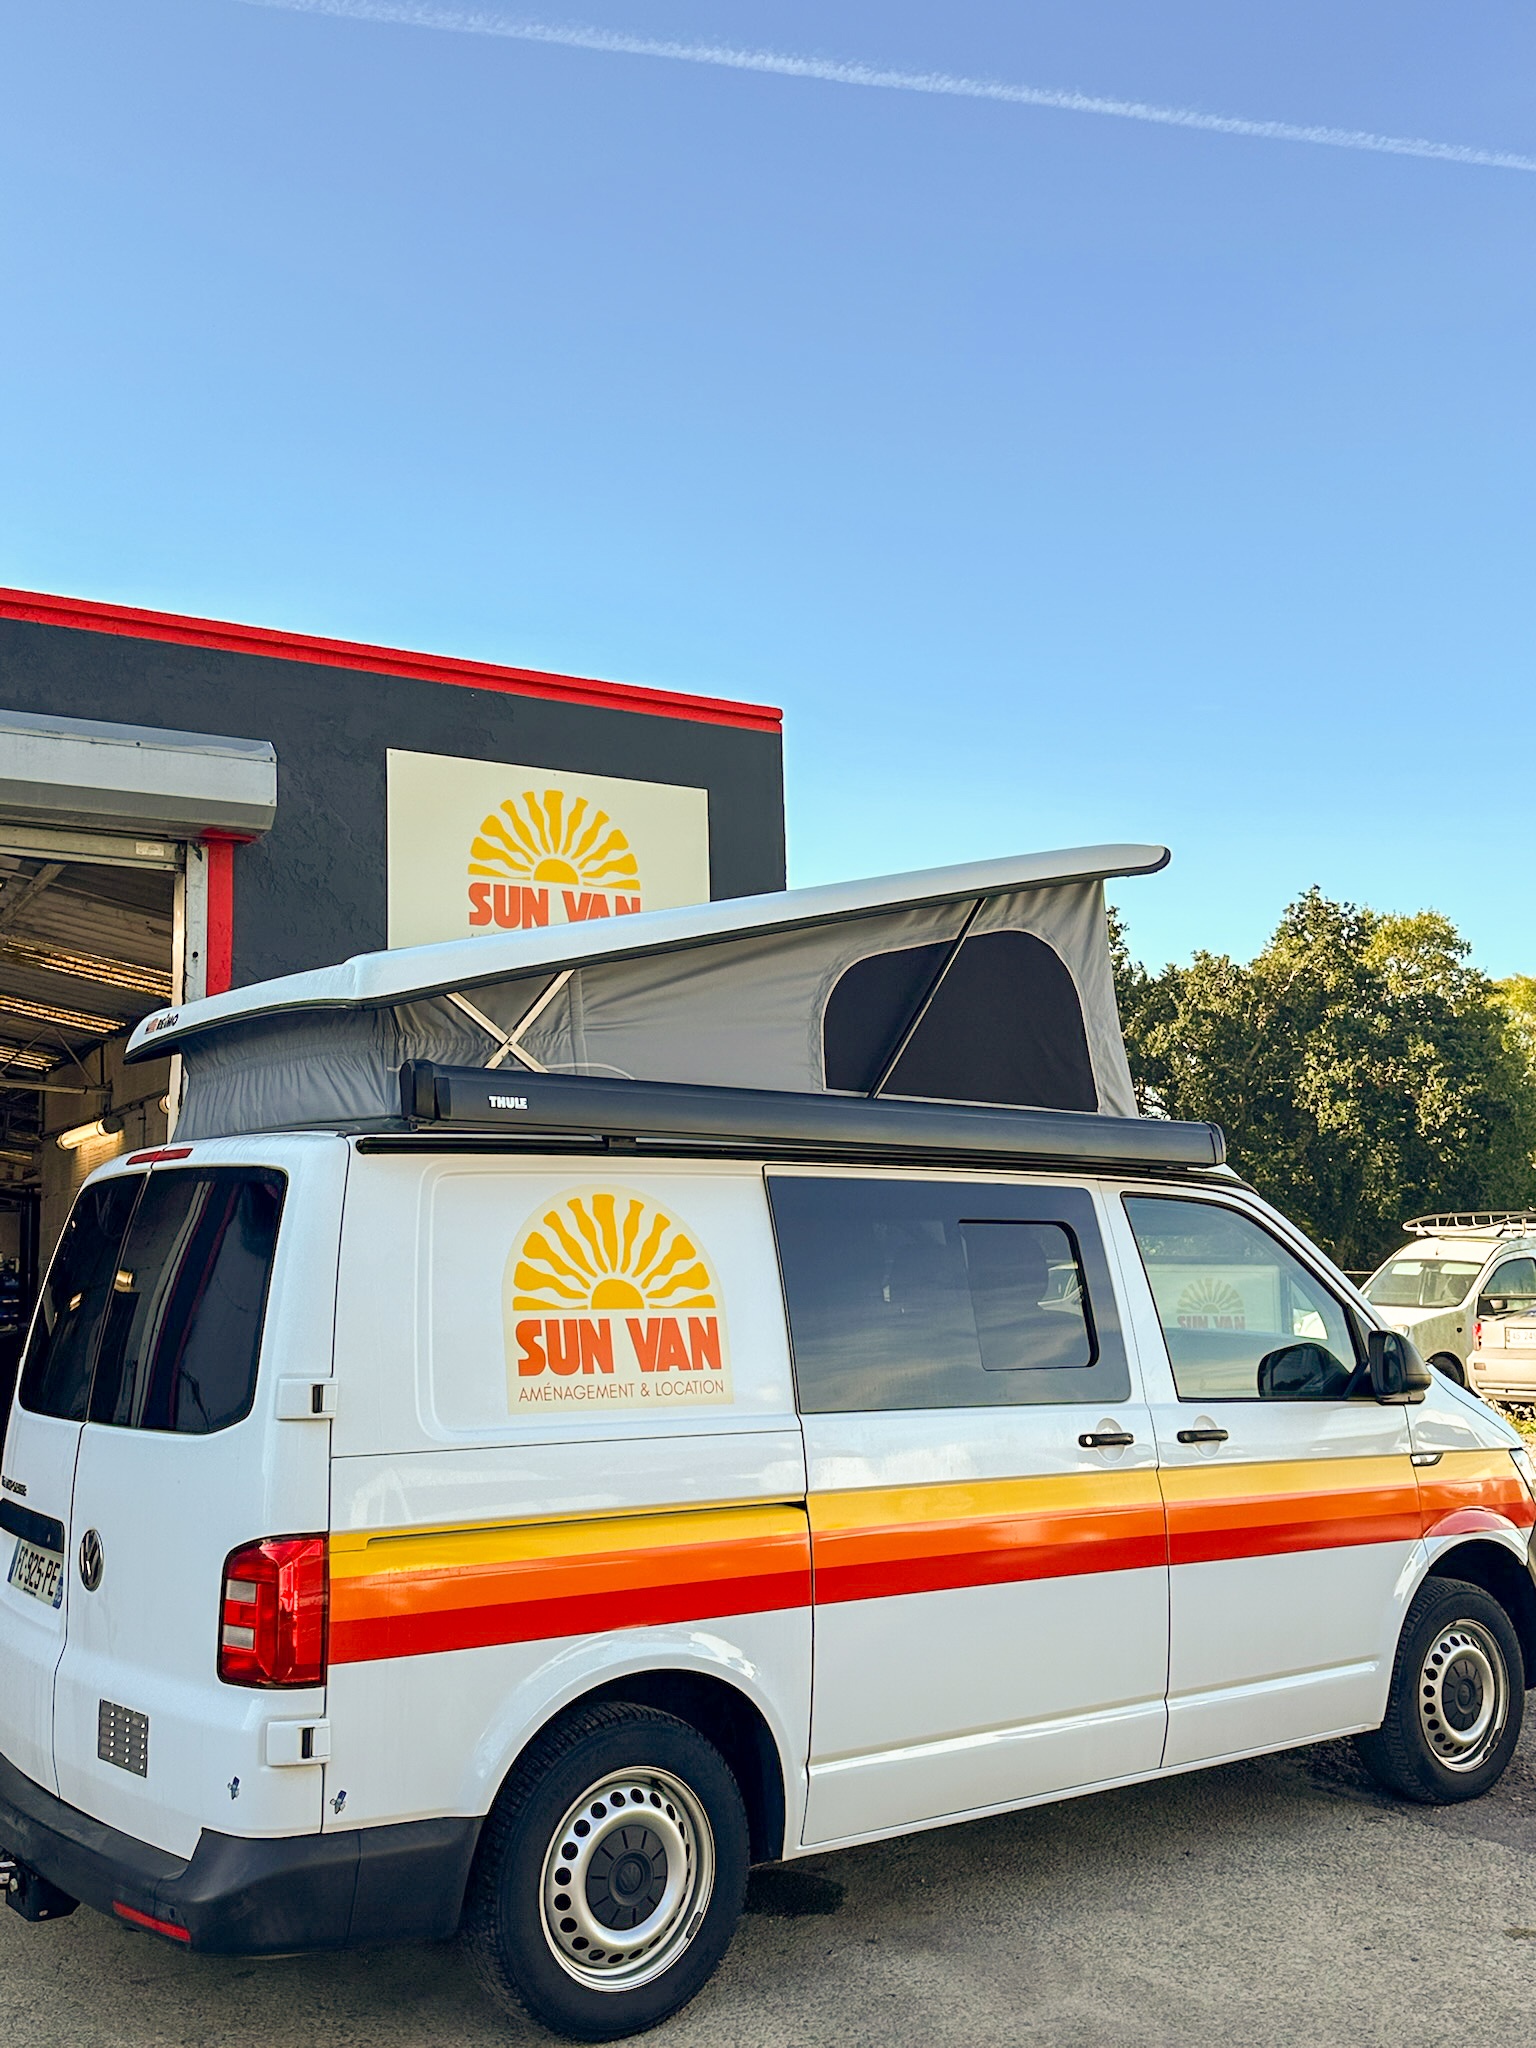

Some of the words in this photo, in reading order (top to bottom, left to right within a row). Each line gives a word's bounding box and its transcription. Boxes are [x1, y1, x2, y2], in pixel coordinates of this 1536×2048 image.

[468, 882, 549, 929] SUN
[488, 1096, 528, 1110] THULE
[515, 1319, 614, 1376] SUN
[625, 1316, 722, 1373] VAN
[518, 1382, 635, 1402] AMÉNAGEMENT
[640, 1383, 650, 1397] &
[655, 1379, 724, 1396] LOCATION
